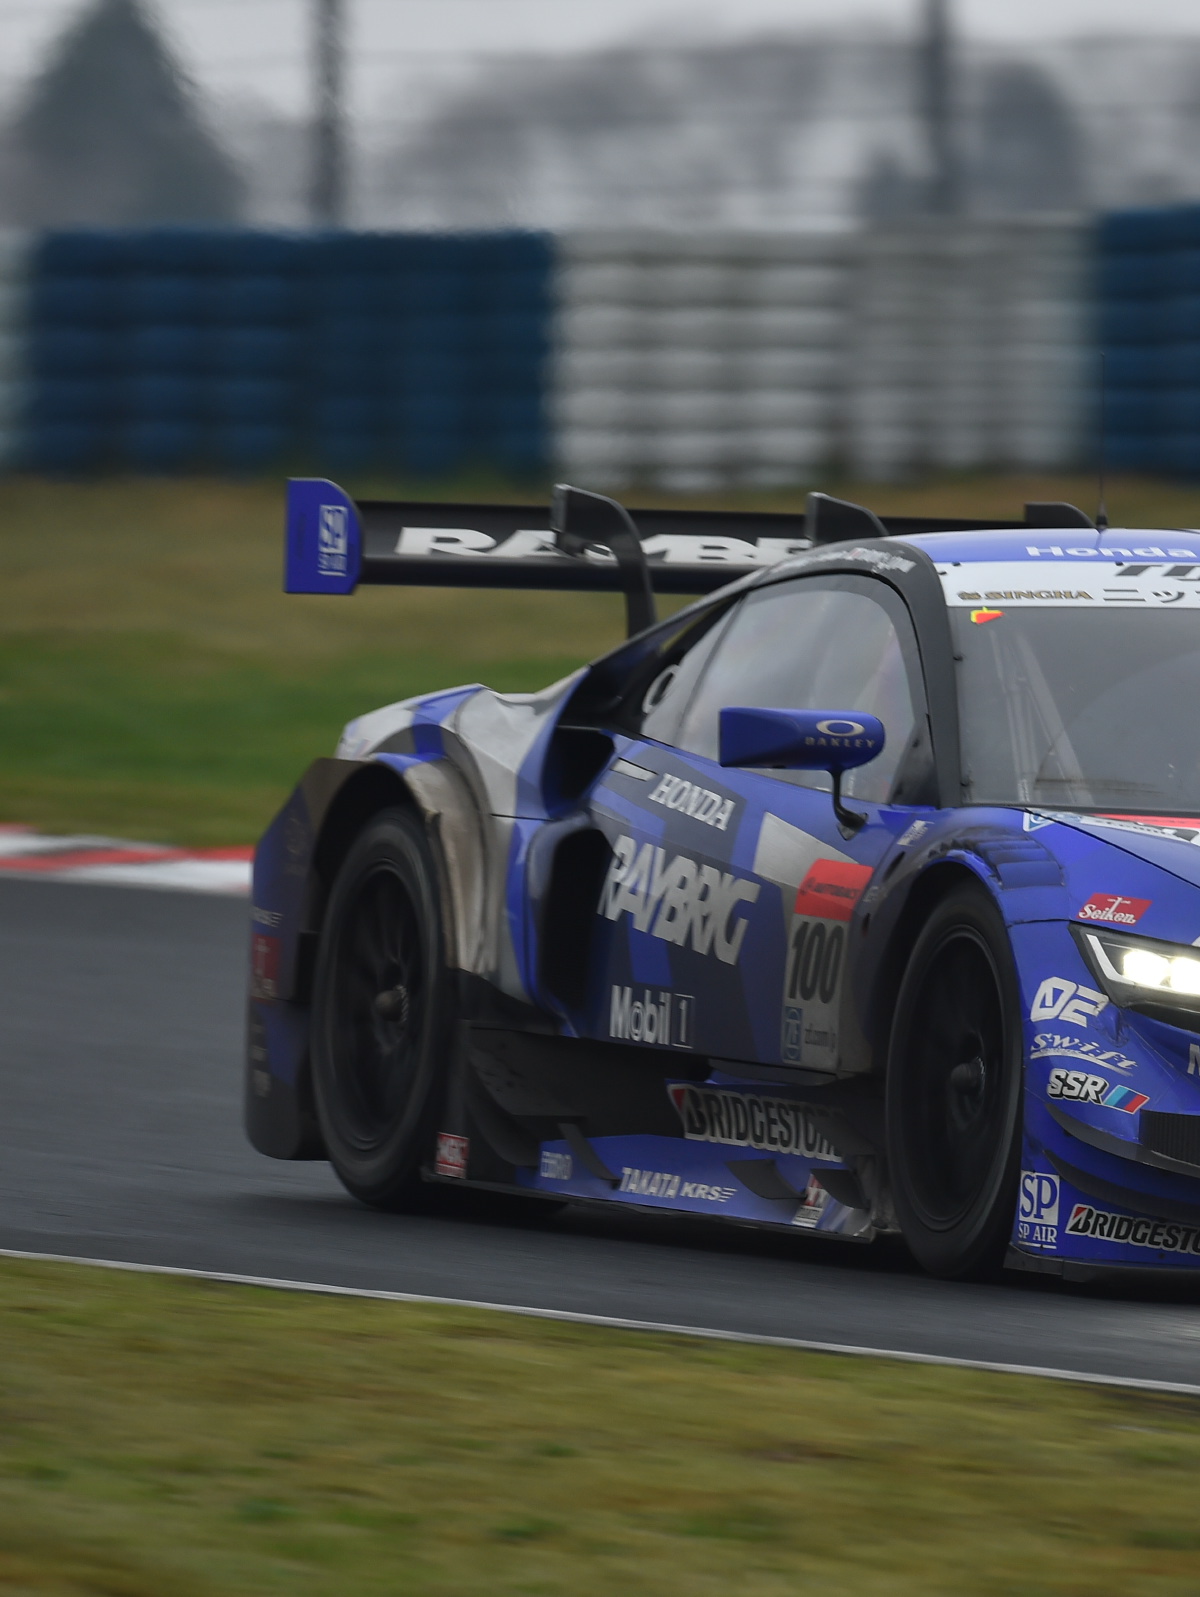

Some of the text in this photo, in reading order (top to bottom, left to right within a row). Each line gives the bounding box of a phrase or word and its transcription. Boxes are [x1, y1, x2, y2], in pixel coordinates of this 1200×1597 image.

[1025, 546, 1197, 558] Honda
[984, 589, 1095, 601] SINGHA
[804, 736, 875, 748] OAKLEY
[648, 772, 736, 832] HONDA
[597, 834, 762, 966] RAYBRIG
[1078, 896, 1136, 924] Seiken
[788, 921, 844, 1004] 100
[609, 984, 672, 1046] Mobil
[1047, 1068, 1109, 1105] SSR
[619, 1167, 681, 1199] TAKATA
[1020, 1173, 1058, 1220] SP
[1018, 1222, 1058, 1243] SP AIR
